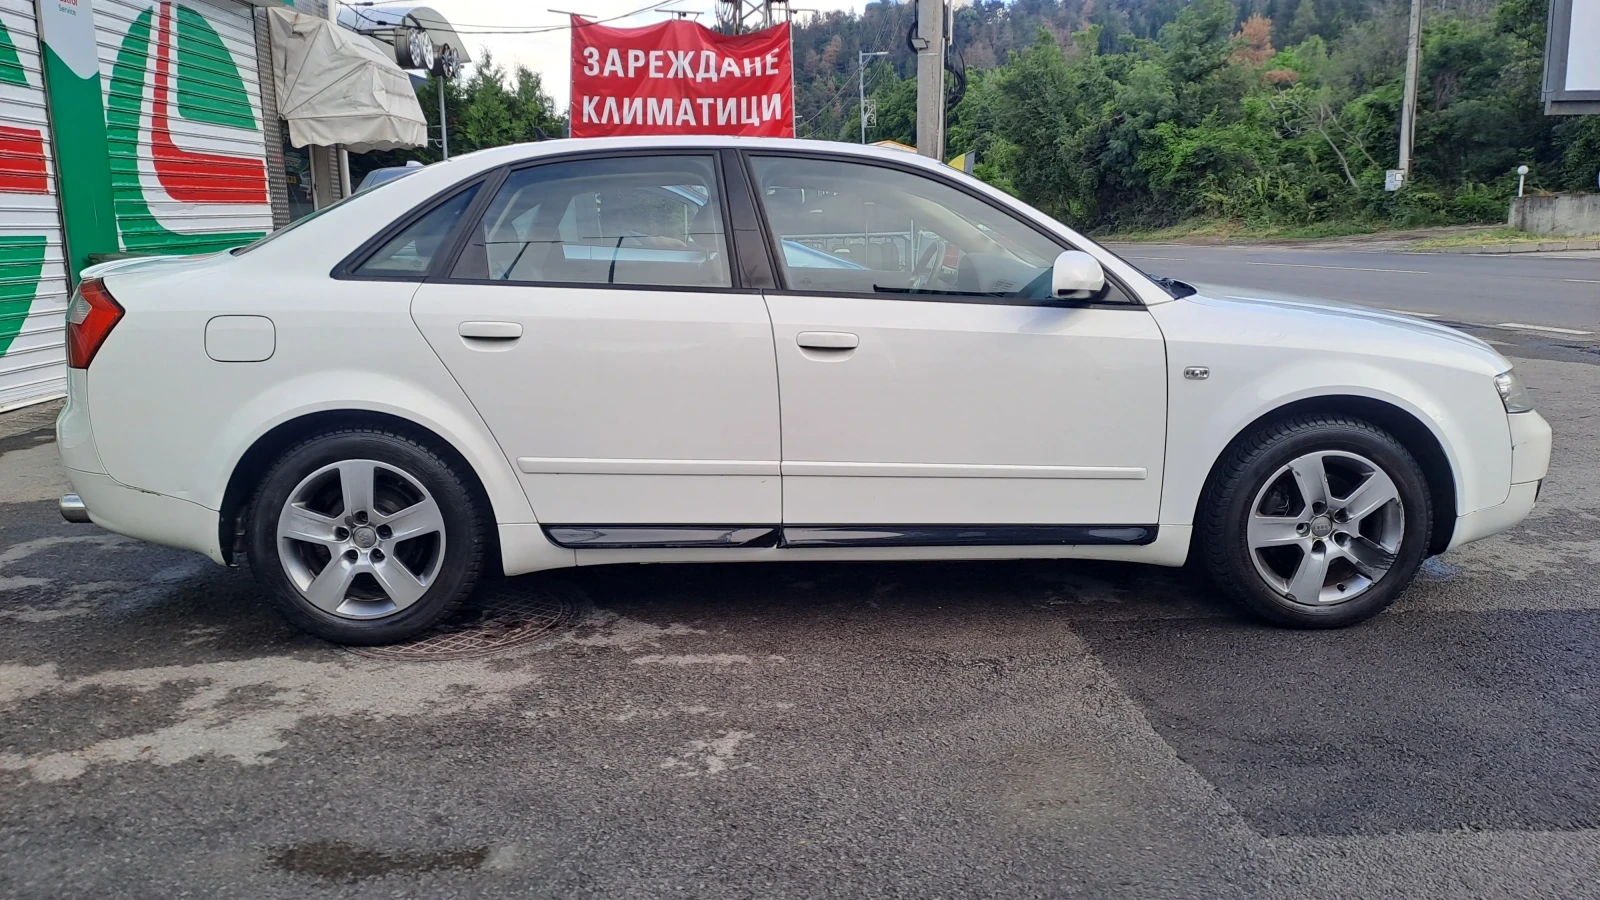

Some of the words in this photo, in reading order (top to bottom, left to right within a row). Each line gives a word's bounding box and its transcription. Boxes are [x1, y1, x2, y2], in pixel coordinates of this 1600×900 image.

[58, 3, 76, 16] Service
[583, 46, 779, 82] ЗАРЕЖДАНЕ
[582, 93, 782, 127] КЛИМАТИЦИ
